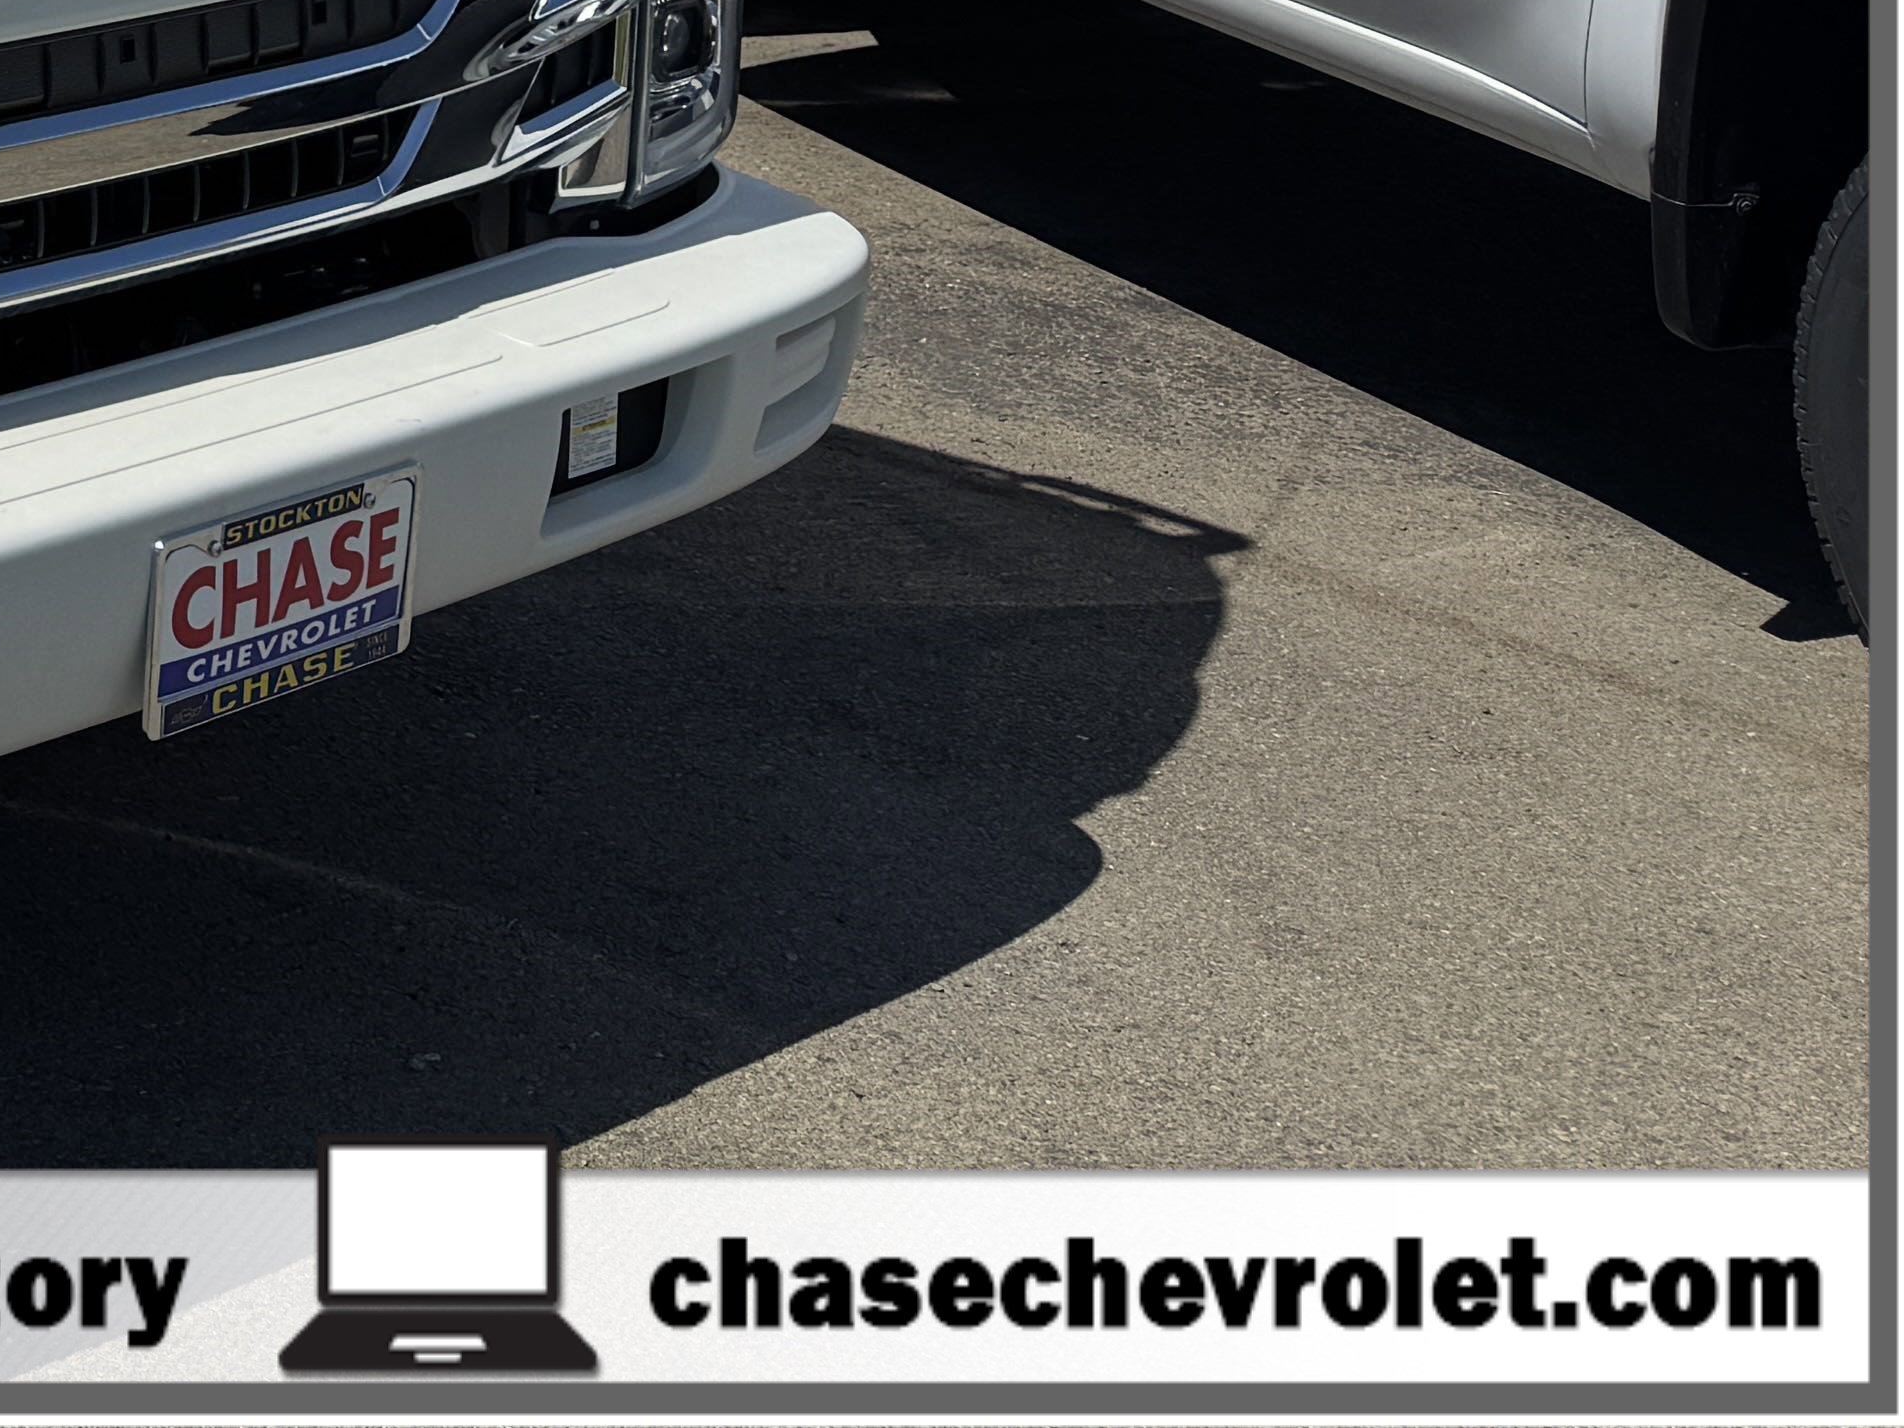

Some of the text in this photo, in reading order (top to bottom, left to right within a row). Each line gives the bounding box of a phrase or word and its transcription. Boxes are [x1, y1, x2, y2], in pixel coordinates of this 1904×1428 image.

[226, 487, 362, 544] STOCKTON
[171, 507, 400, 649] CHASE
[187, 599, 376, 683] CHEVROLET
[212, 643, 355, 715] CHASE
